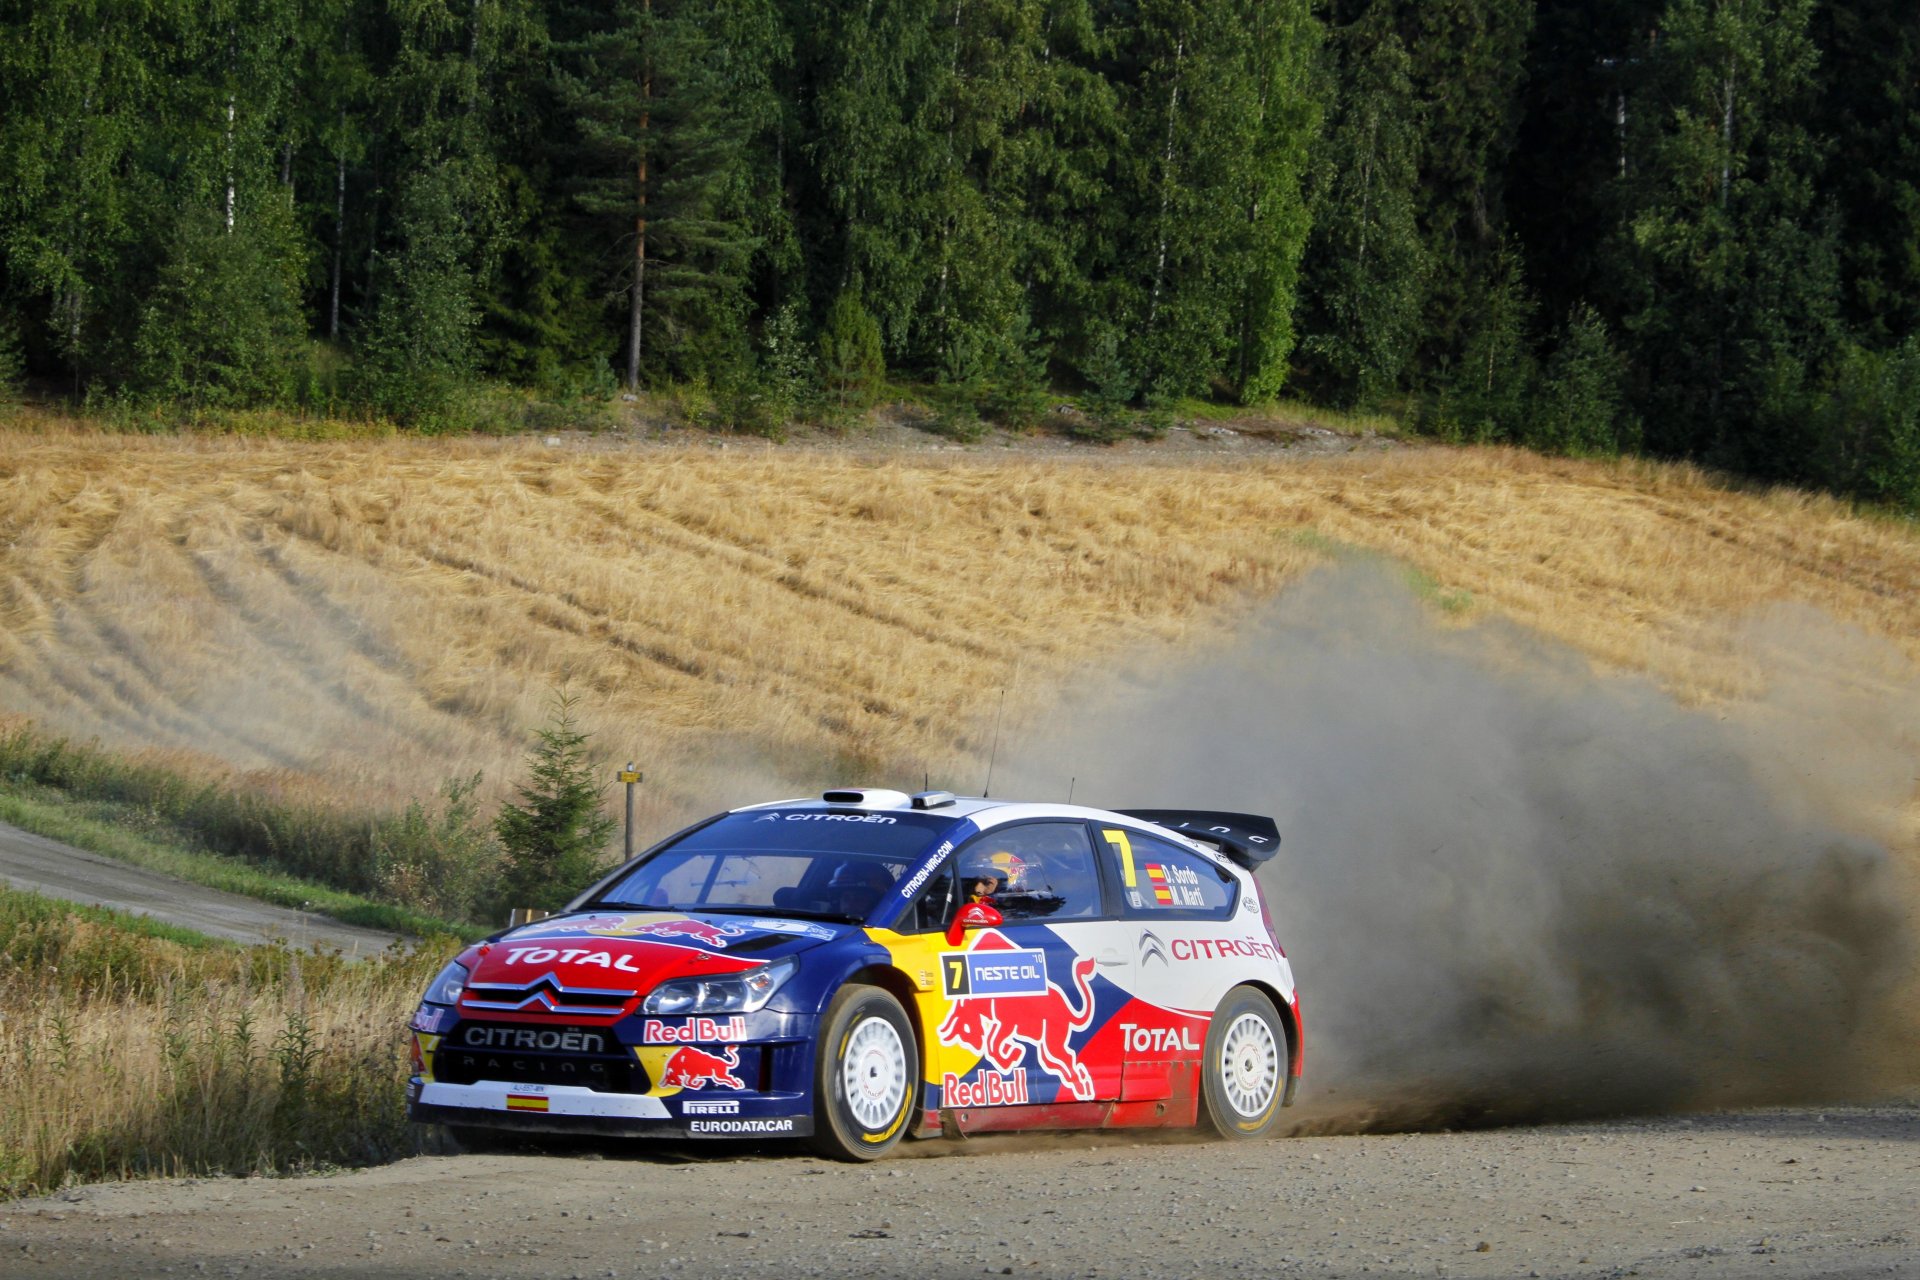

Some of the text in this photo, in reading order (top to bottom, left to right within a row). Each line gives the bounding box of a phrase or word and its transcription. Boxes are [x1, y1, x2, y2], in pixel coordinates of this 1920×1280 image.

[901, 840, 954, 898] CITROEN-WRC.COM
[1102, 829, 1136, 888] 7
[1161, 864, 1198, 885] D. Sordo
[1168, 886, 1183, 906] M.
[504, 946, 640, 973] TOTAL
[949, 961, 963, 989] 7
[974, 965, 1040, 981] NESTE OIL
[644, 1016, 747, 1042] Red Bull
[1119, 1023, 1200, 1052] TOTAL
[463, 1055, 604, 1073] RACING
[943, 1067, 1028, 1108] Red Bull
[682, 1100, 740, 1114] PIRELLI
[690, 1120, 793, 1132] EURODATACAR
